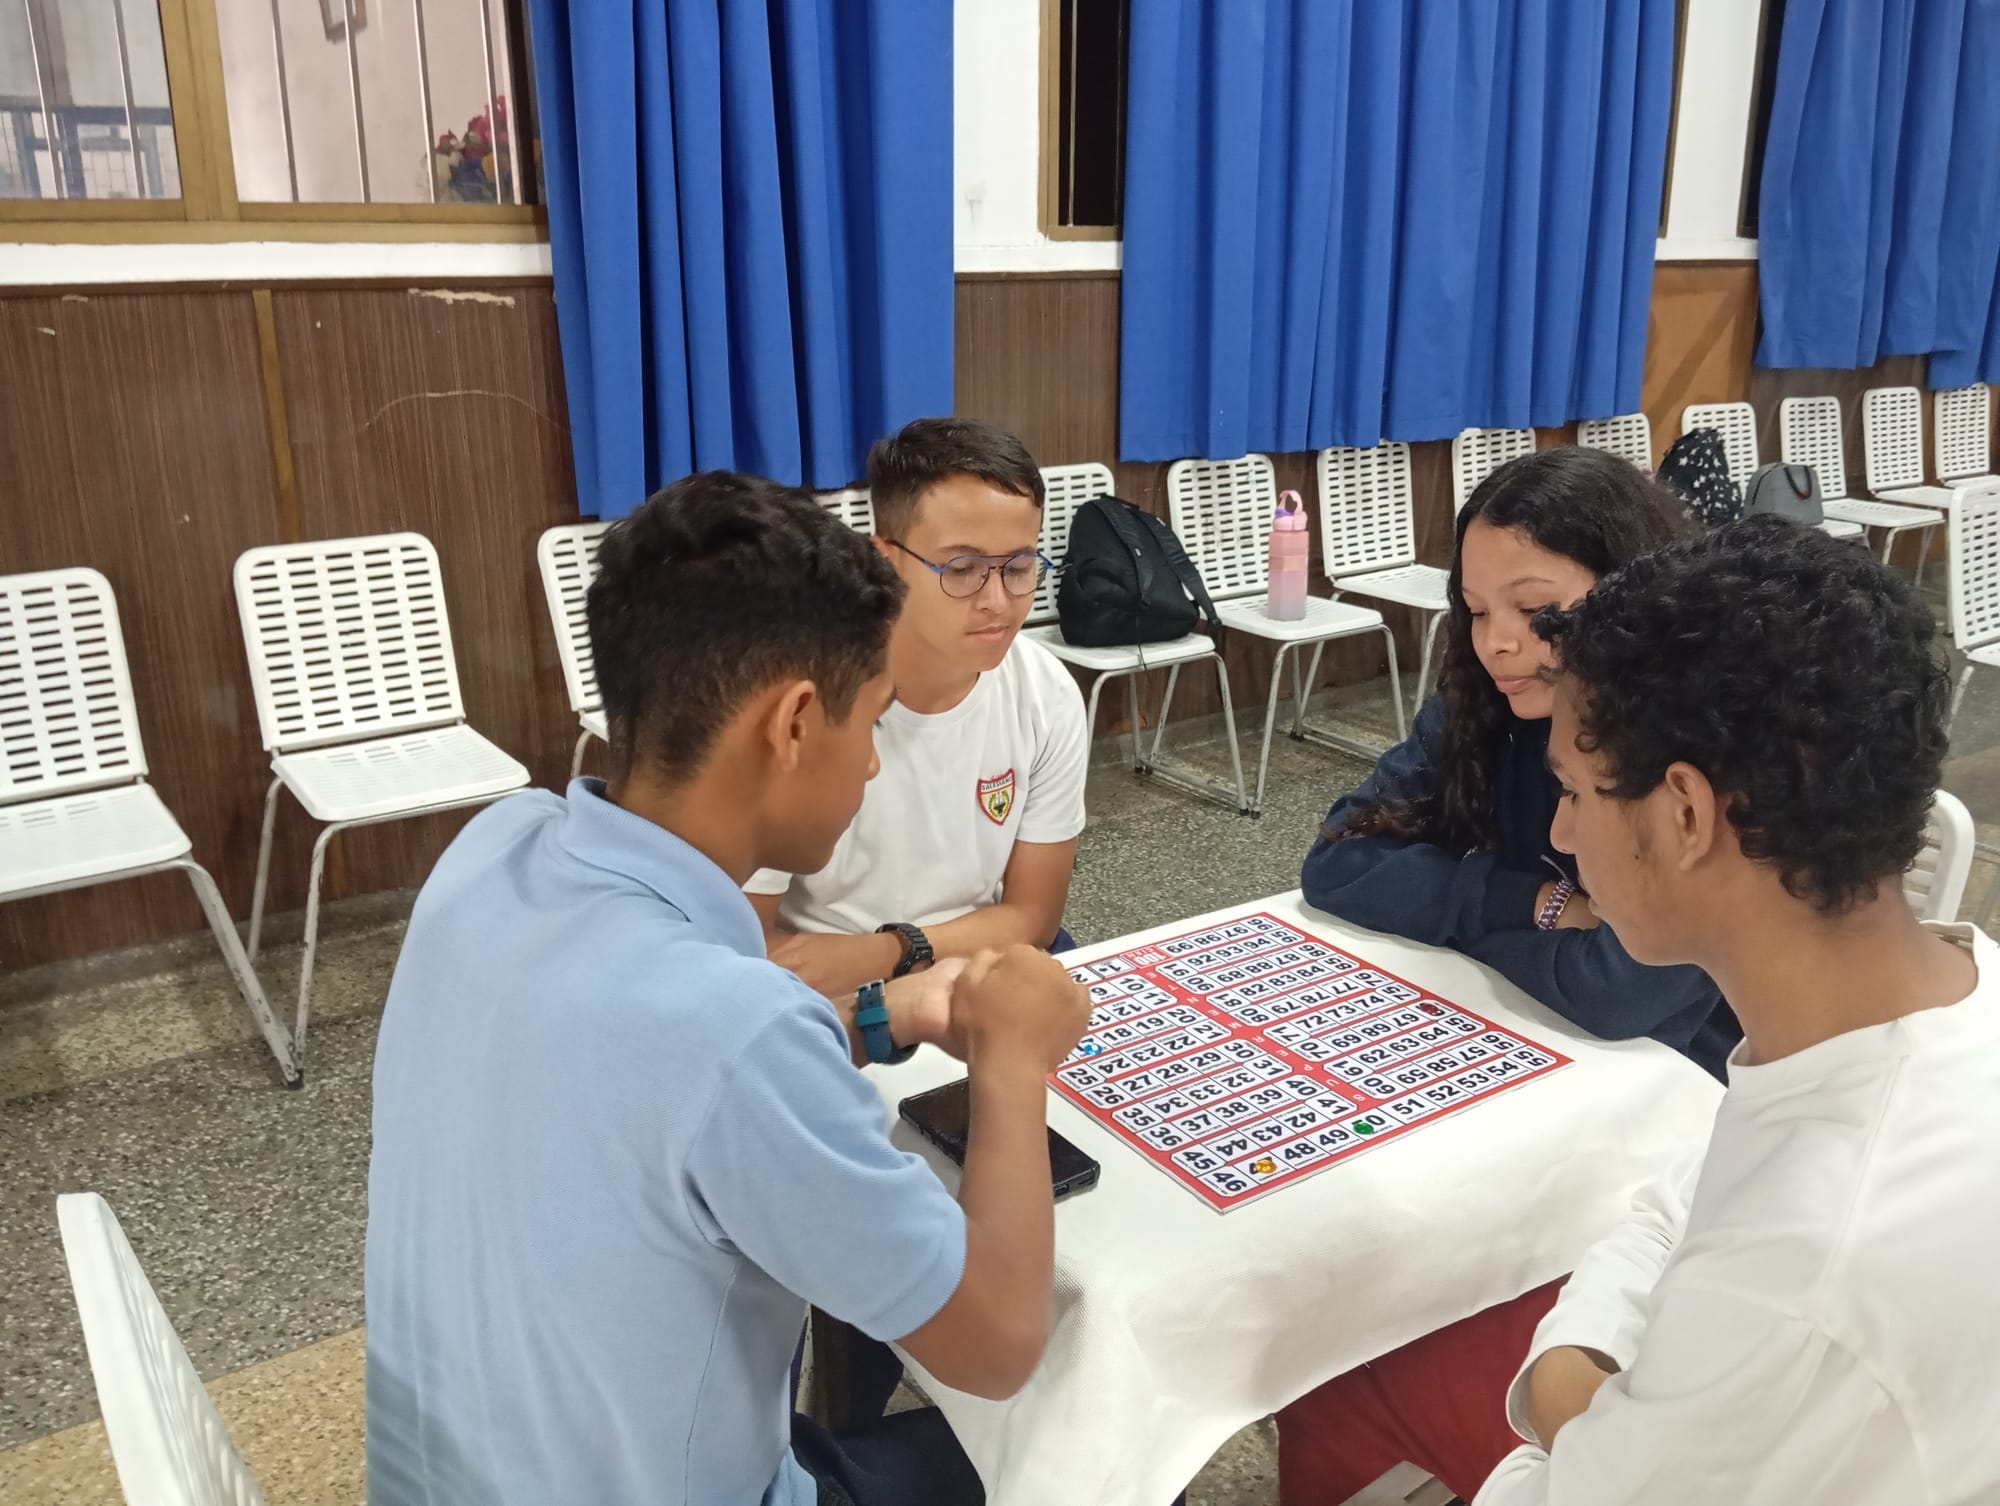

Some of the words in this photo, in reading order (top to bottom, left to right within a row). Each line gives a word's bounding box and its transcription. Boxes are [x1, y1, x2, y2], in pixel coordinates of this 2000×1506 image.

[1224, 926, 1248, 938] 97
[1247, 918, 1272, 931] 96
[1194, 934, 1222, 945] 98
[1163, 963, 1189, 976] 91
[1187, 954, 1216, 966] 92
[1215, 946, 1243, 957] 93
[1243, 938, 1271, 949] 94
[1270, 931, 1297, 943] 95
[1166, 942, 1194, 953] 99
[1299, 944, 1326, 957] 86
[1135, 952, 1166, 965] 100
[1275, 953, 1300, 965] 87
[1245, 962, 1273, 974] 88
[1072, 974, 1088, 983] 2
[1214, 993, 1242, 1006] 81
[1240, 983, 1269, 996] 82
[1268, 974, 1297, 986] 83
[1296, 965, 1325, 977] 84
[1324, 957, 1352, 970] 85
[1217, 970, 1245, 982] 89
[1354, 972, 1382, 986] 76
[1091, 987, 1108, 996] 9
[1120, 977, 1144, 991] 10
[1187, 977, 1214, 991] 90
[1331, 982, 1358, 995] 77
[1143, 992, 1169, 1005] 11
[1300, 991, 1330, 1004] 78
[1112, 1004, 1142, 1016] 12
[1240, 1008, 1269, 1022] 80
[1271, 1001, 1301, 1014] 79
[1271, 1026, 1300, 1041] 71
[1295, 1015, 1328, 1028] 72
[1325, 1005, 1356, 1018] 73
[1354, 995, 1385, 1008] 74
[1382, 986, 1411, 1000] 75
[1102, 1028, 1132, 1041] 18
[1136, 1017, 1164, 1030] 19
[1167, 1009, 1197, 1024] 20
[1393, 1013, 1420, 1026] 67
[1193, 1025, 1223, 1039] 21
[1361, 1023, 1391, 1036] 68
[1163, 1036, 1196, 1051] 22
[1331, 1034, 1361, 1047] 69
[1331, 1060, 1363, 1076] 61
[1359, 1049, 1392, 1063] 62
[1389, 1038, 1420, 1051] 63
[1419, 1027, 1449, 1041] 64
[1444, 1017, 1476, 1032] 65
[1481, 1034, 1514, 1050] 56
[1132, 1047, 1164, 1062] 23
[1300, 1042, 1330, 1058] 70
[1459, 1046, 1488, 1061] 57
[1098, 1058, 1131, 1074] 24
[1253, 1060, 1284, 1076] 31
[1426, 1057, 1459, 1072] 58
[1066, 1068, 1098, 1086] 25
[1091, 1086, 1125, 1104] 26
[1122, 1075, 1152, 1092] 27
[1156, 1064, 1188, 1079] 28
[1190, 1052, 1221, 1067] 29
[1224, 1042, 1254, 1059] 30
[1221, 1072, 1255, 1088] 32
[1396, 1069, 1429, 1084] 59
[1189, 1084, 1222, 1100] 33
[1363, 1077, 1395, 1094] 60
[1150, 1127, 1183, 1146] 36
[1180, 1113, 1211, 1132] 37
[1215, 1102, 1249, 1118] 38
[1249, 1089, 1283, 1105] 39
[1285, 1080, 1317, 1096] 40
[1154, 1097, 1188, 1114] 34
[1318, 1099, 1350, 1115] 41
[1122, 1108, 1155, 1127] 35
[1212, 1172, 1247, 1192] 46
[1284, 1143, 1316, 1160] 48
[1319, 1129, 1350, 1146] 49
[1392, 1098, 1425, 1115] 51
[1425, 1085, 1459, 1101] 52
[1456, 1073, 1489, 1088] 53
[1486, 1061, 1518, 1076] 54
[1513, 1050, 1548, 1067] 55
[1284, 1112, 1316, 1128] 42
[1251, 1125, 1282, 1141] 43
[1216, 1139, 1247, 1156] 44
[1182, 1151, 1217, 1169] 45
